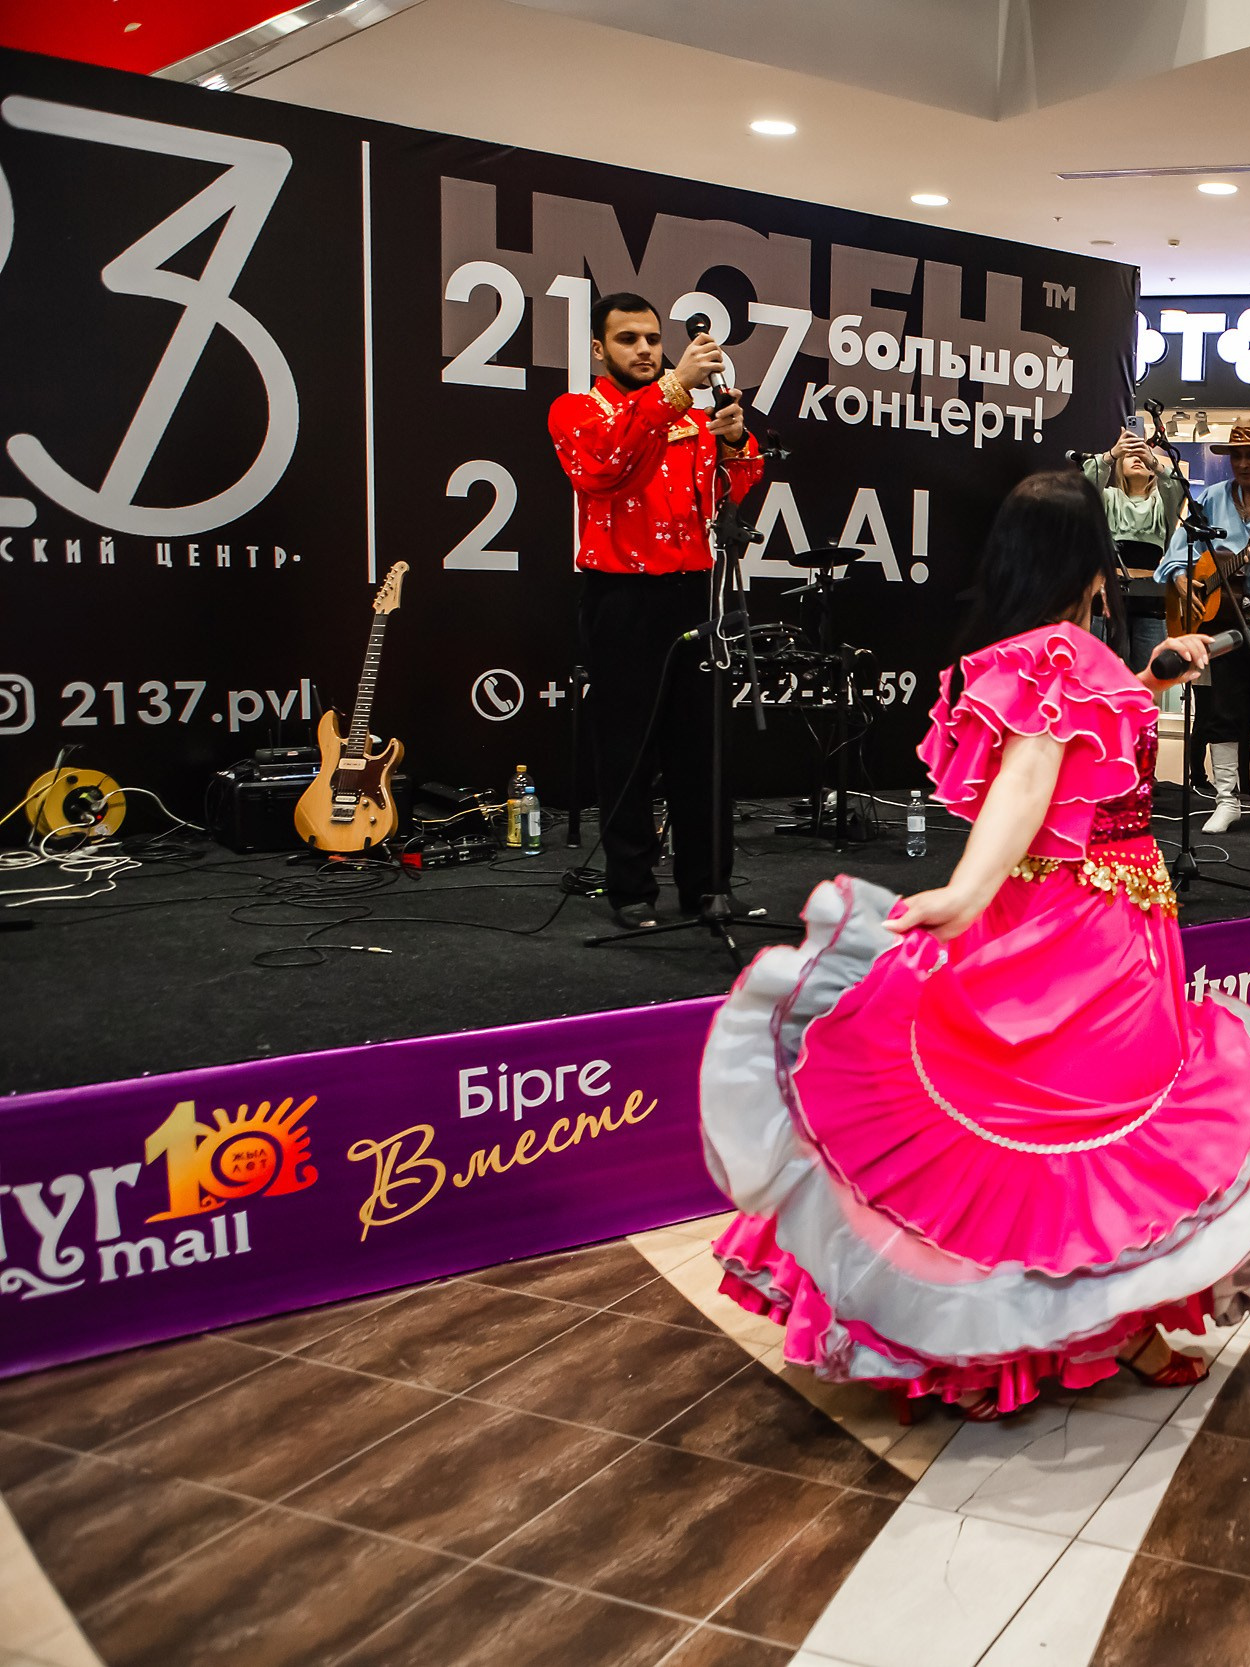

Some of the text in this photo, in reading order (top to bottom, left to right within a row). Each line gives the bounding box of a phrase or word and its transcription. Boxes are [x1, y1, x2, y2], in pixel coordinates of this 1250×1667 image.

[828, 314, 1074, 394] большой
[798, 382, 1043, 449] концерт!
[443, 460, 519, 571] 2
[61, 678, 312, 733] 2137.pvl
[458, 1059, 612, 1121] Бірге
[346, 1089, 658, 1242] Вместе
[99, 1210, 252, 1283] mall
